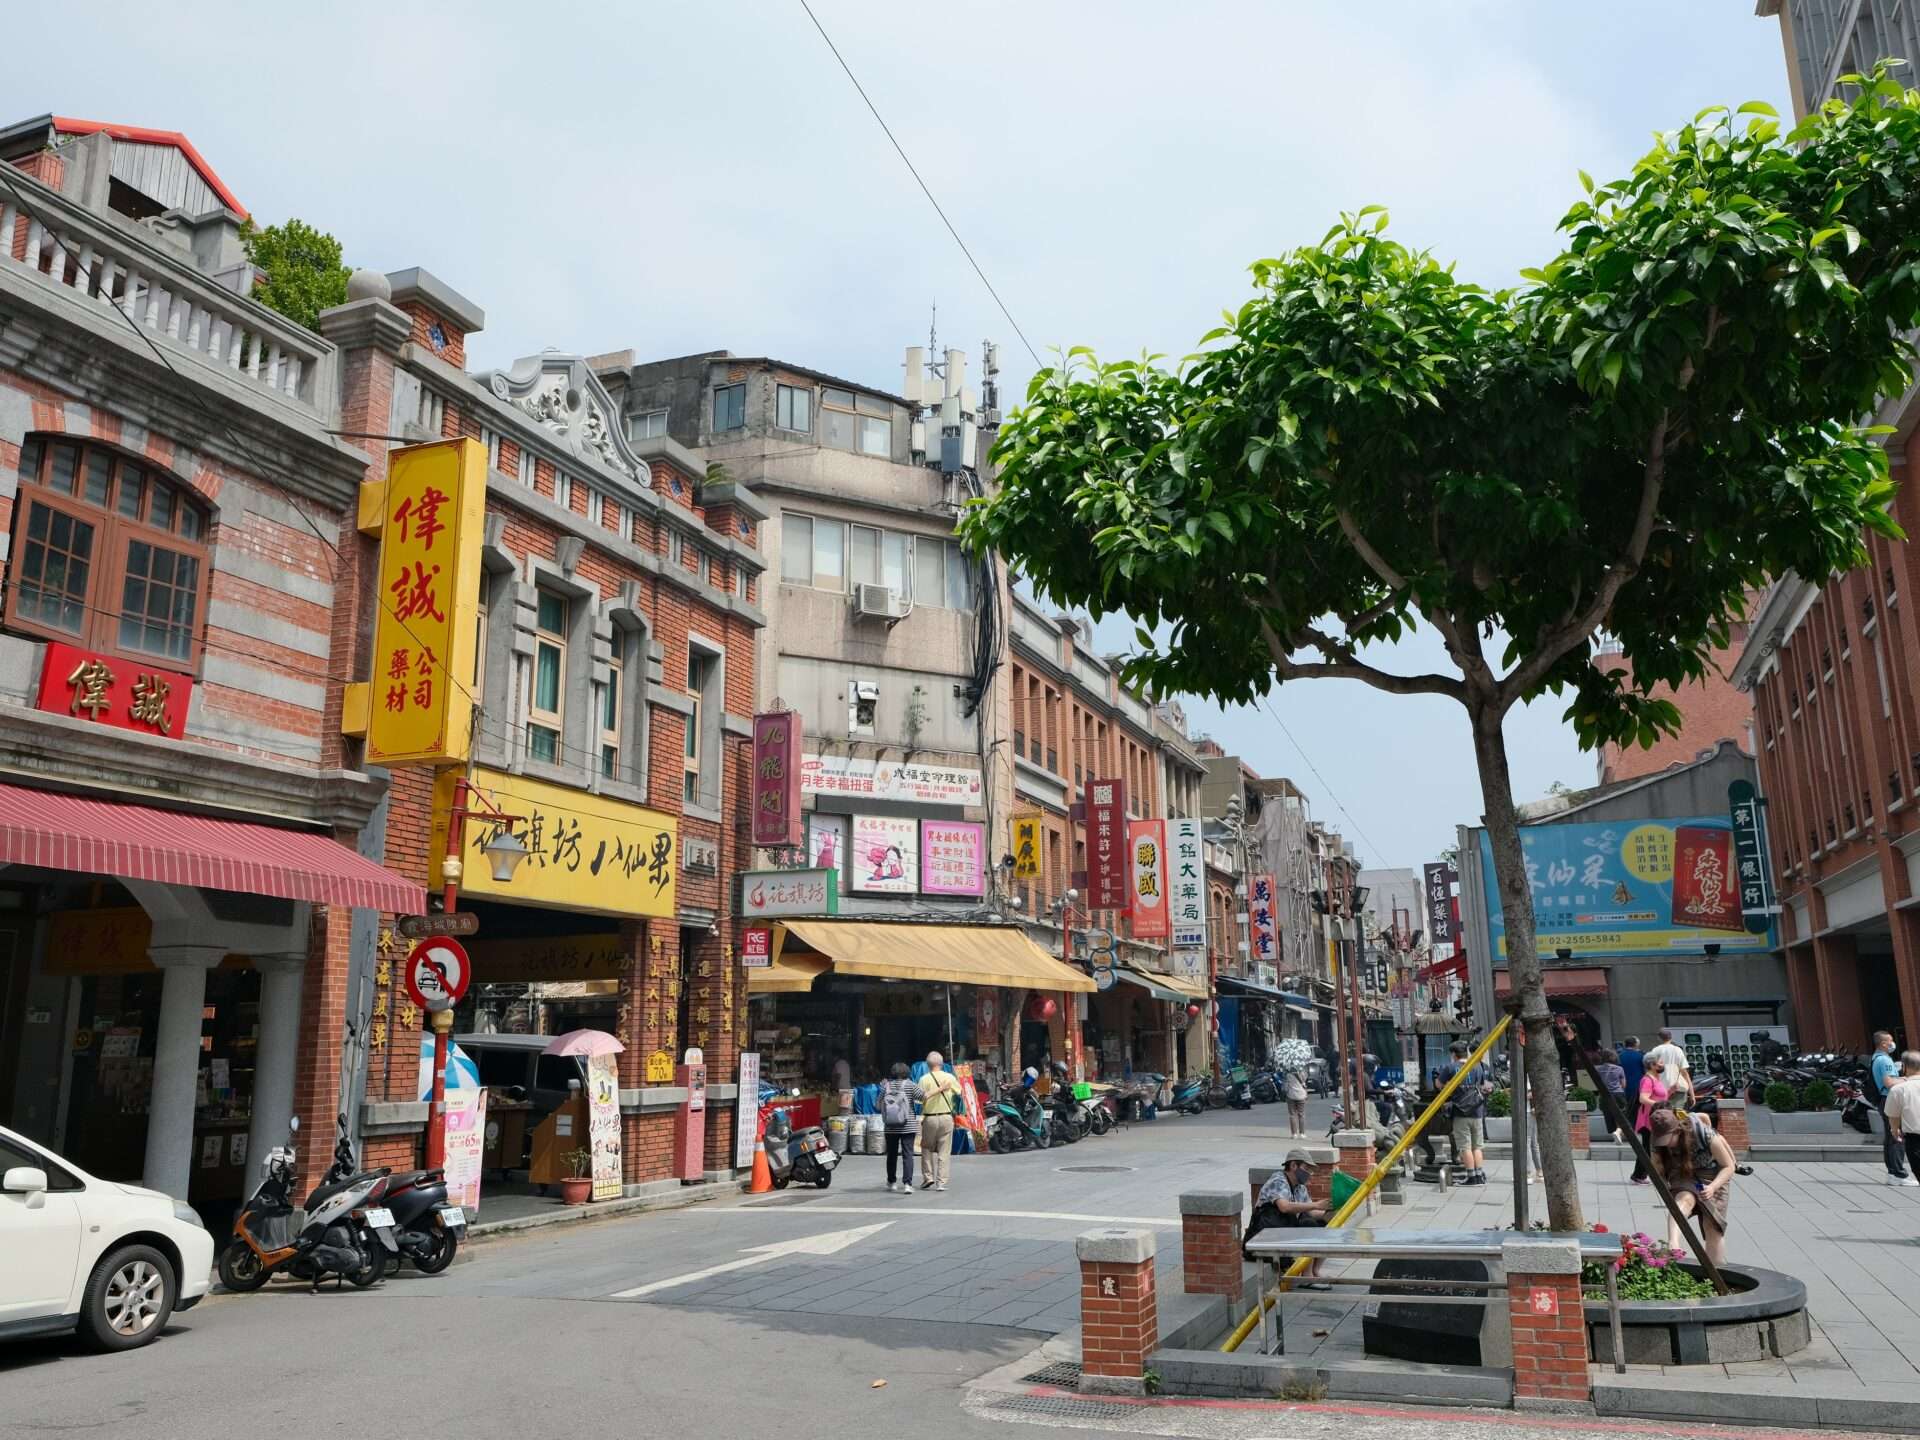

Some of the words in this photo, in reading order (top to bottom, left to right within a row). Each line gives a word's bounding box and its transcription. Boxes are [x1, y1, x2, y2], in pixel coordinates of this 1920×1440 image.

[392, 486, 450, 625] 偉誠
[67, 659, 173, 736] 偉誠
[385, 649, 411, 713] 藥材
[412, 644, 438, 709] 公司
[1734, 807, 1761, 904] 第一銀行
[1252, 881, 1273, 954] 萬安堂
[1102, 1276, 1117, 1296] 霞
[1534, 1291, 1553, 1312] 海
